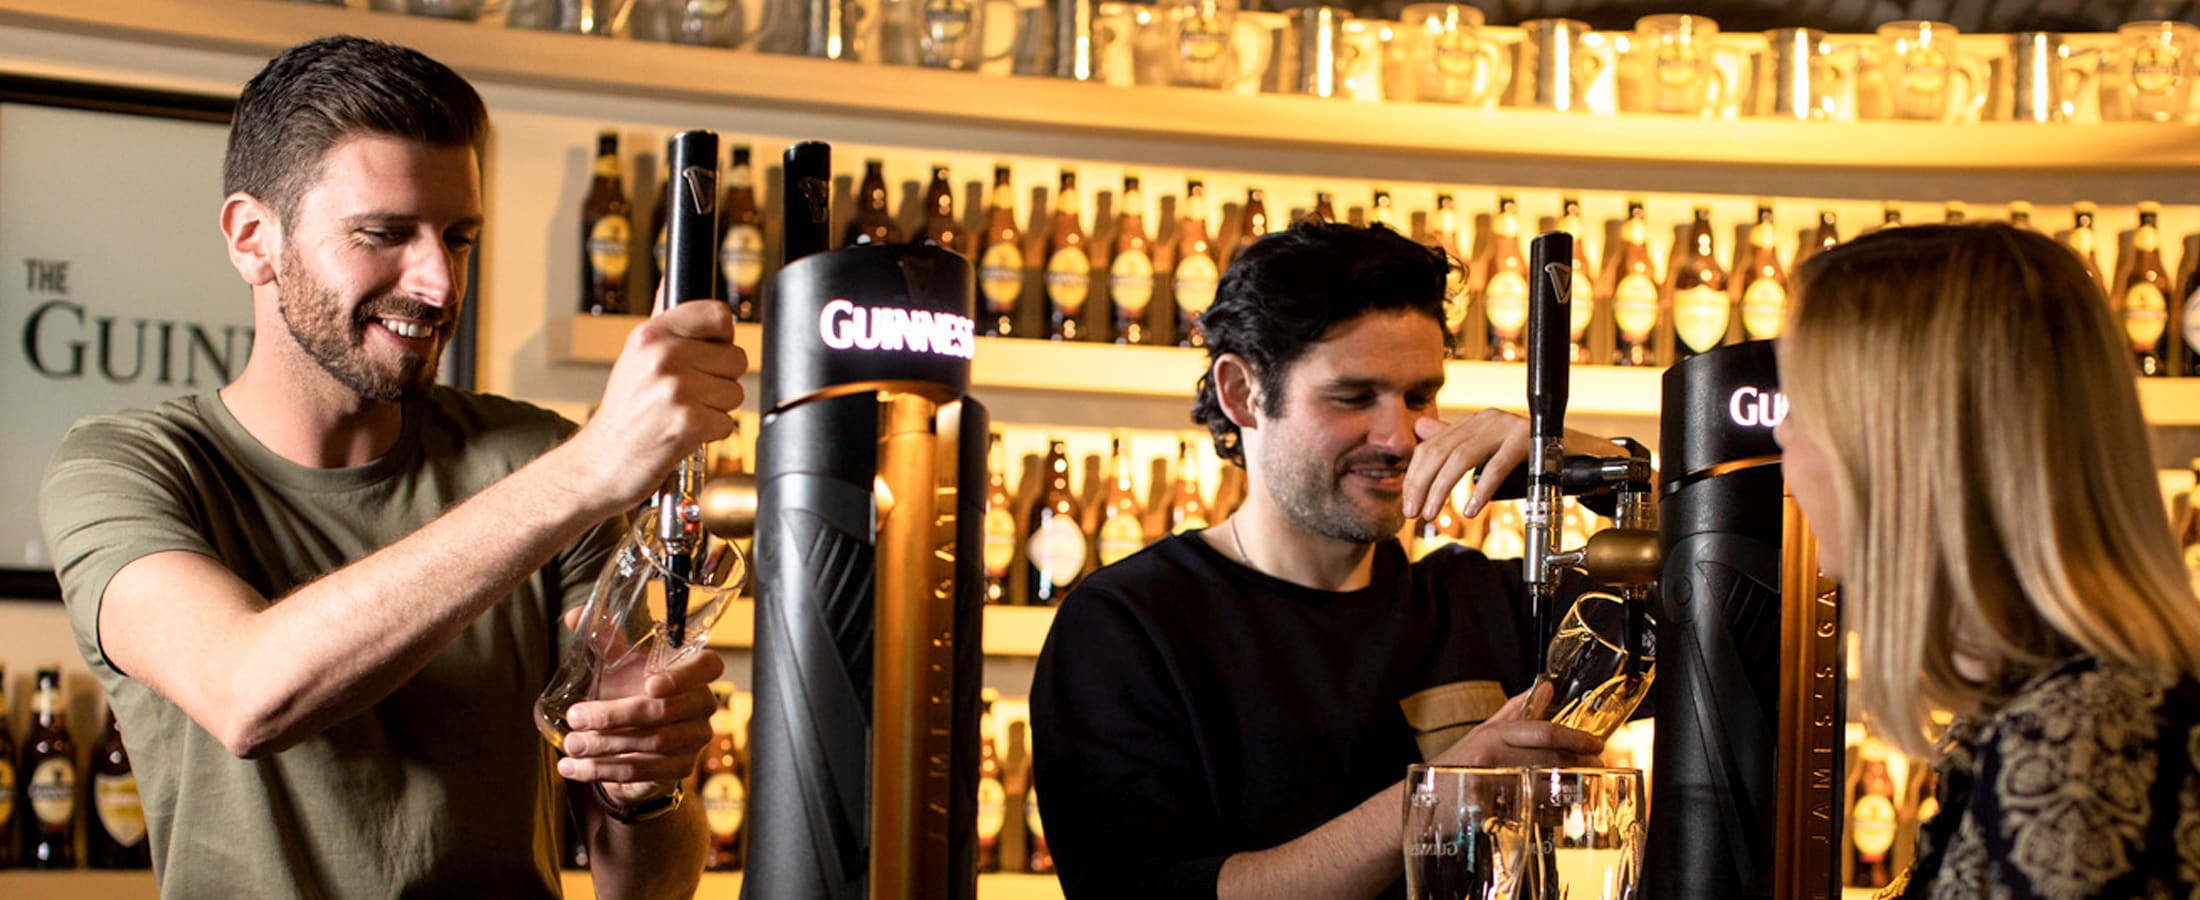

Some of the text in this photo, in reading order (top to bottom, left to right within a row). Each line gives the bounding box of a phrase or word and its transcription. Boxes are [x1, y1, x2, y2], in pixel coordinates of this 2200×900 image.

[24, 258, 70, 293] THE
[22, 299, 256, 386] GUIN
[1815, 571, 1837, 638] GA
